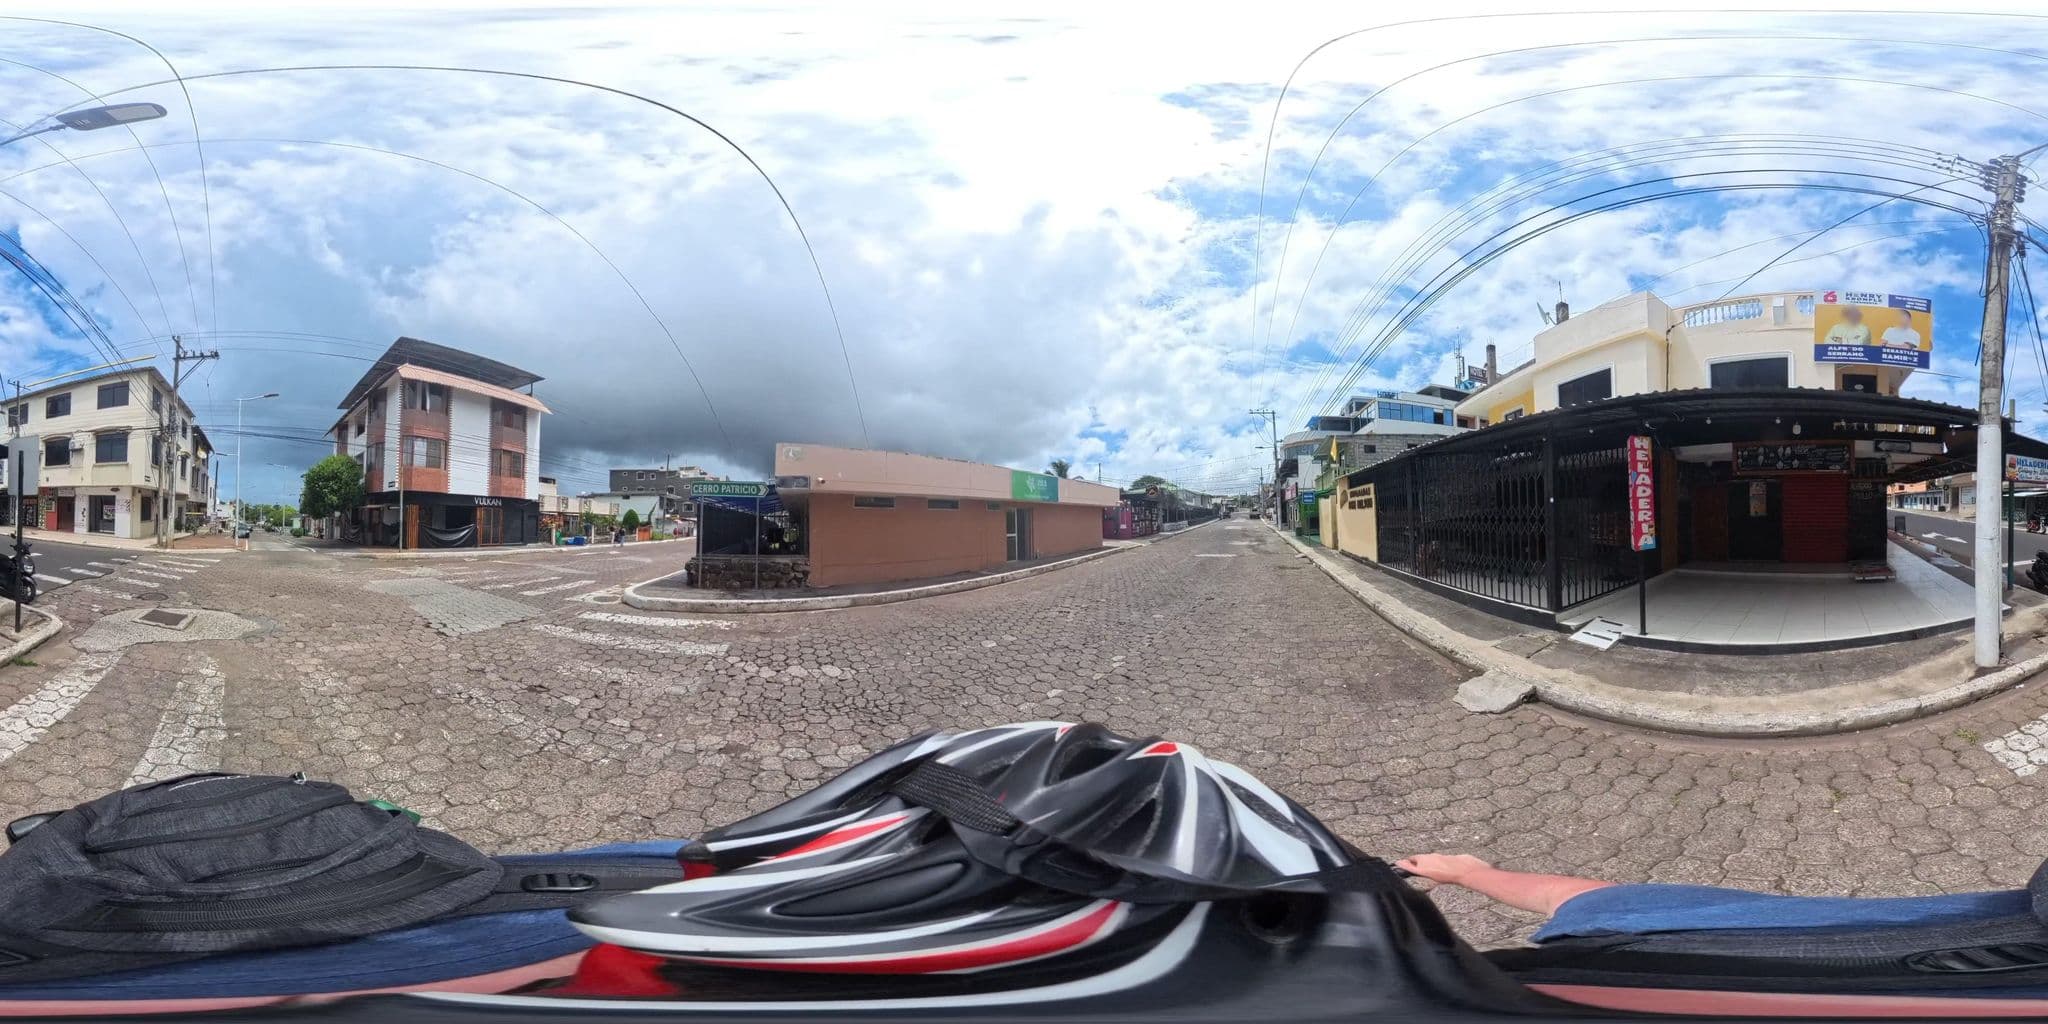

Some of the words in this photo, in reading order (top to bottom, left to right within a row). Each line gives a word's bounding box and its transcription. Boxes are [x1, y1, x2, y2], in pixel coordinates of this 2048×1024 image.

[693, 484, 719, 493] CERRO
[721, 485, 757, 494] PATRICIO
[1634, 436, 1654, 546] HELADERIA
[474, 496, 502, 506] VULKAN
